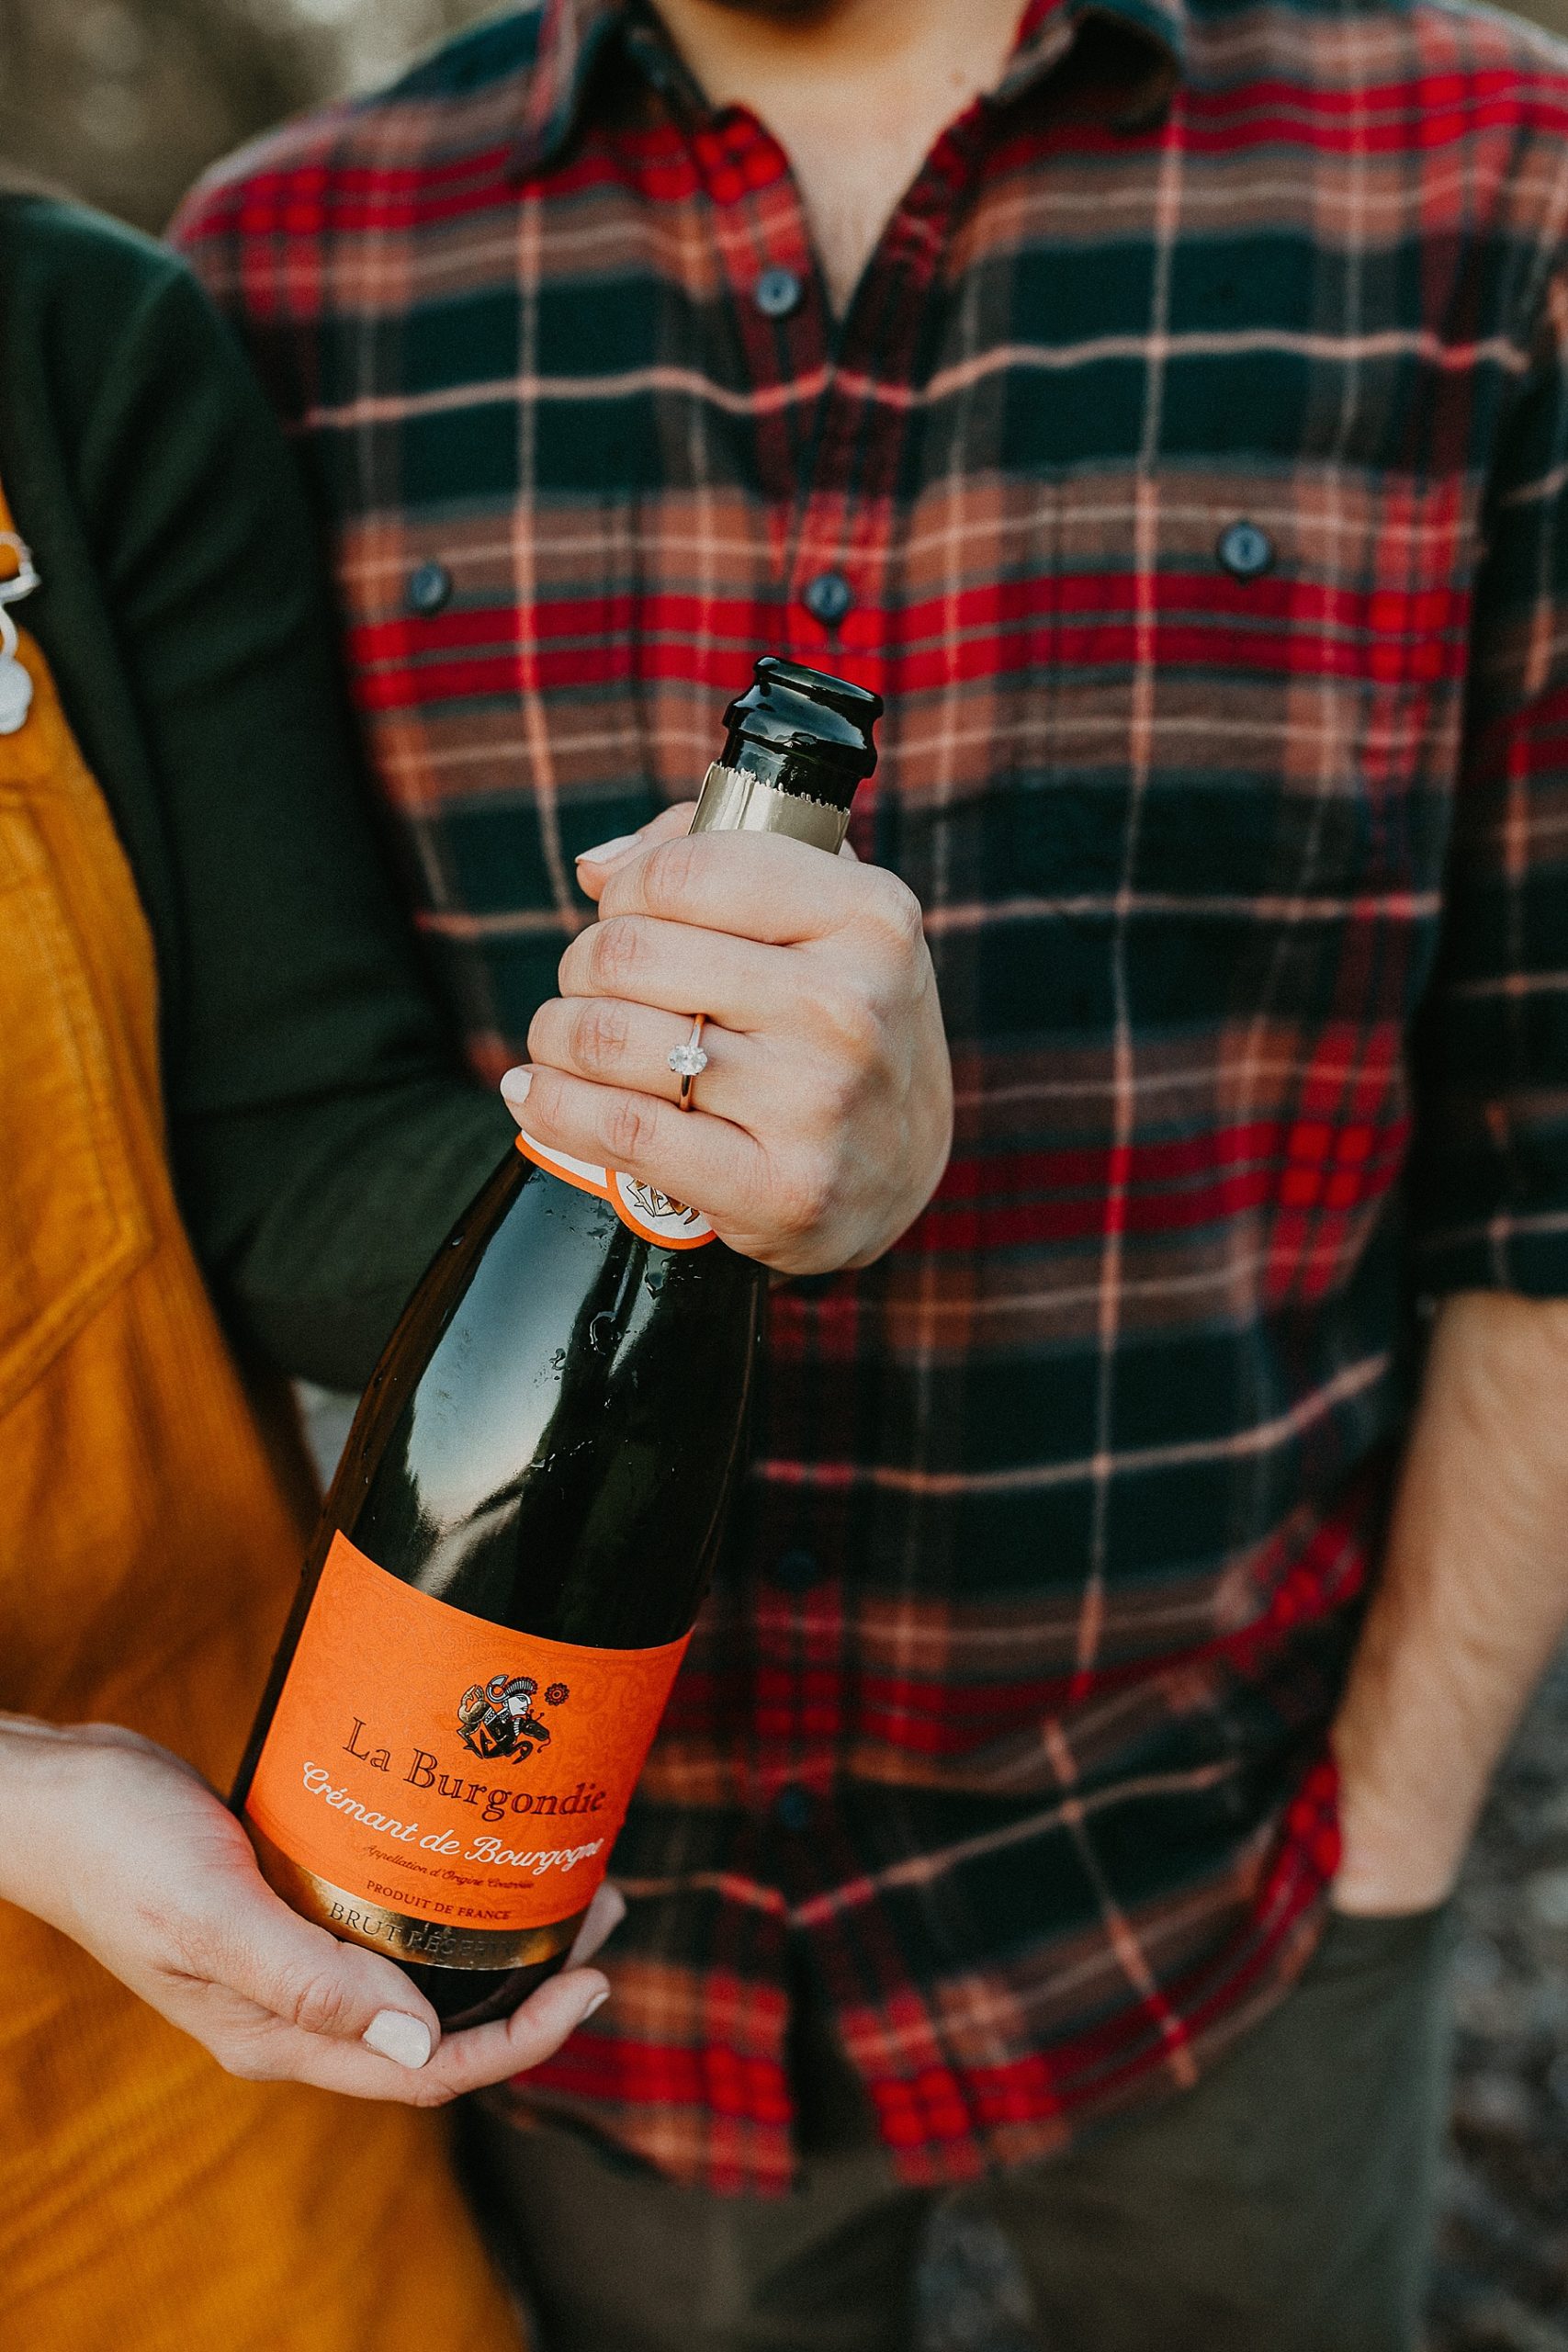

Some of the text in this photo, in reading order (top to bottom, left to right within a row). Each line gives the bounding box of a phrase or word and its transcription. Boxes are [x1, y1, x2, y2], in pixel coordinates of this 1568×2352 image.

[343, 1717, 605, 1822] La Burgondie
[303, 1761, 418, 1840] Crémant
[419, 1829, 460, 1855] de
[363, 1845, 428, 1874] Appellation
[487, 1877, 535, 1889] Contr
[367, 1880, 513, 1920] PRODUIT DE FRANCE
[329, 1902, 513, 1957] BRUT RÉSE
